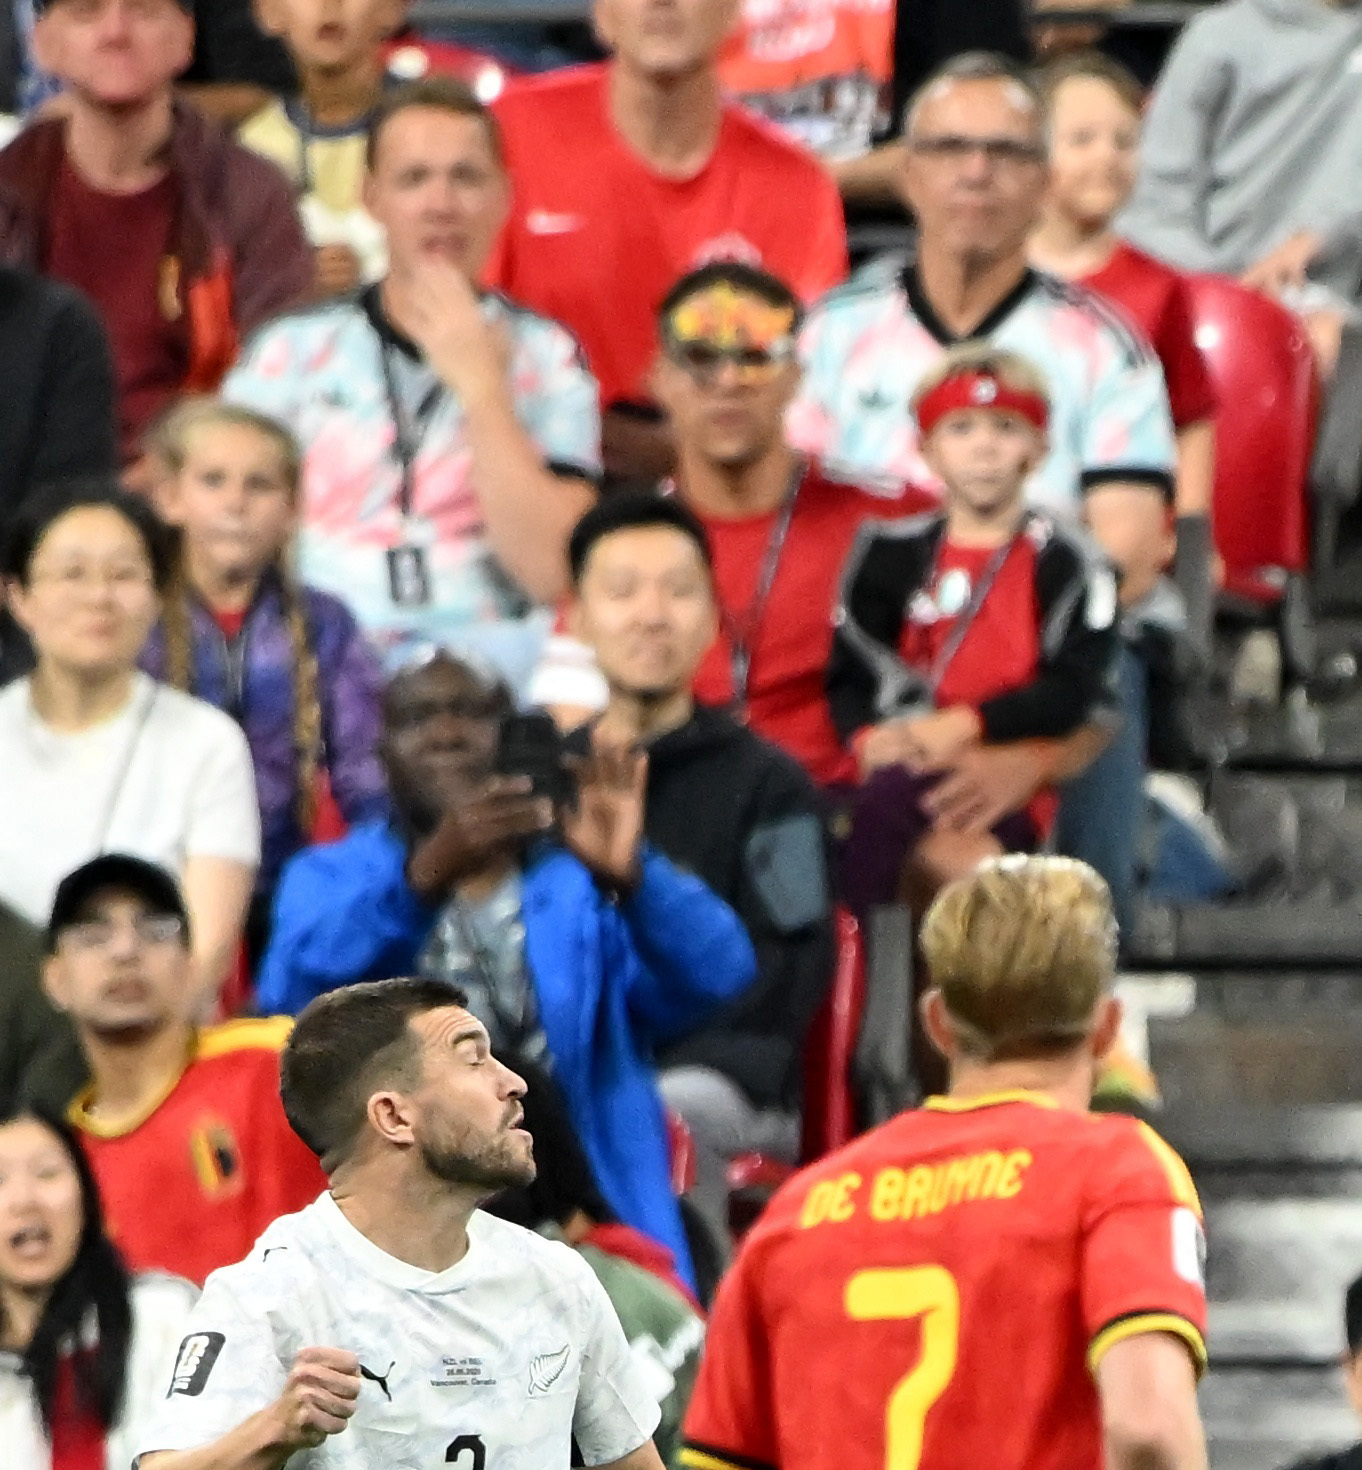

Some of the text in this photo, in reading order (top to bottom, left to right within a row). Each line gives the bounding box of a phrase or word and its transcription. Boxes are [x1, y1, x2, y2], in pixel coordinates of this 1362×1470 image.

[800, 1147, 1033, 1230] DE BRUYNE
[470, 1377, 497, 1386] Canada
